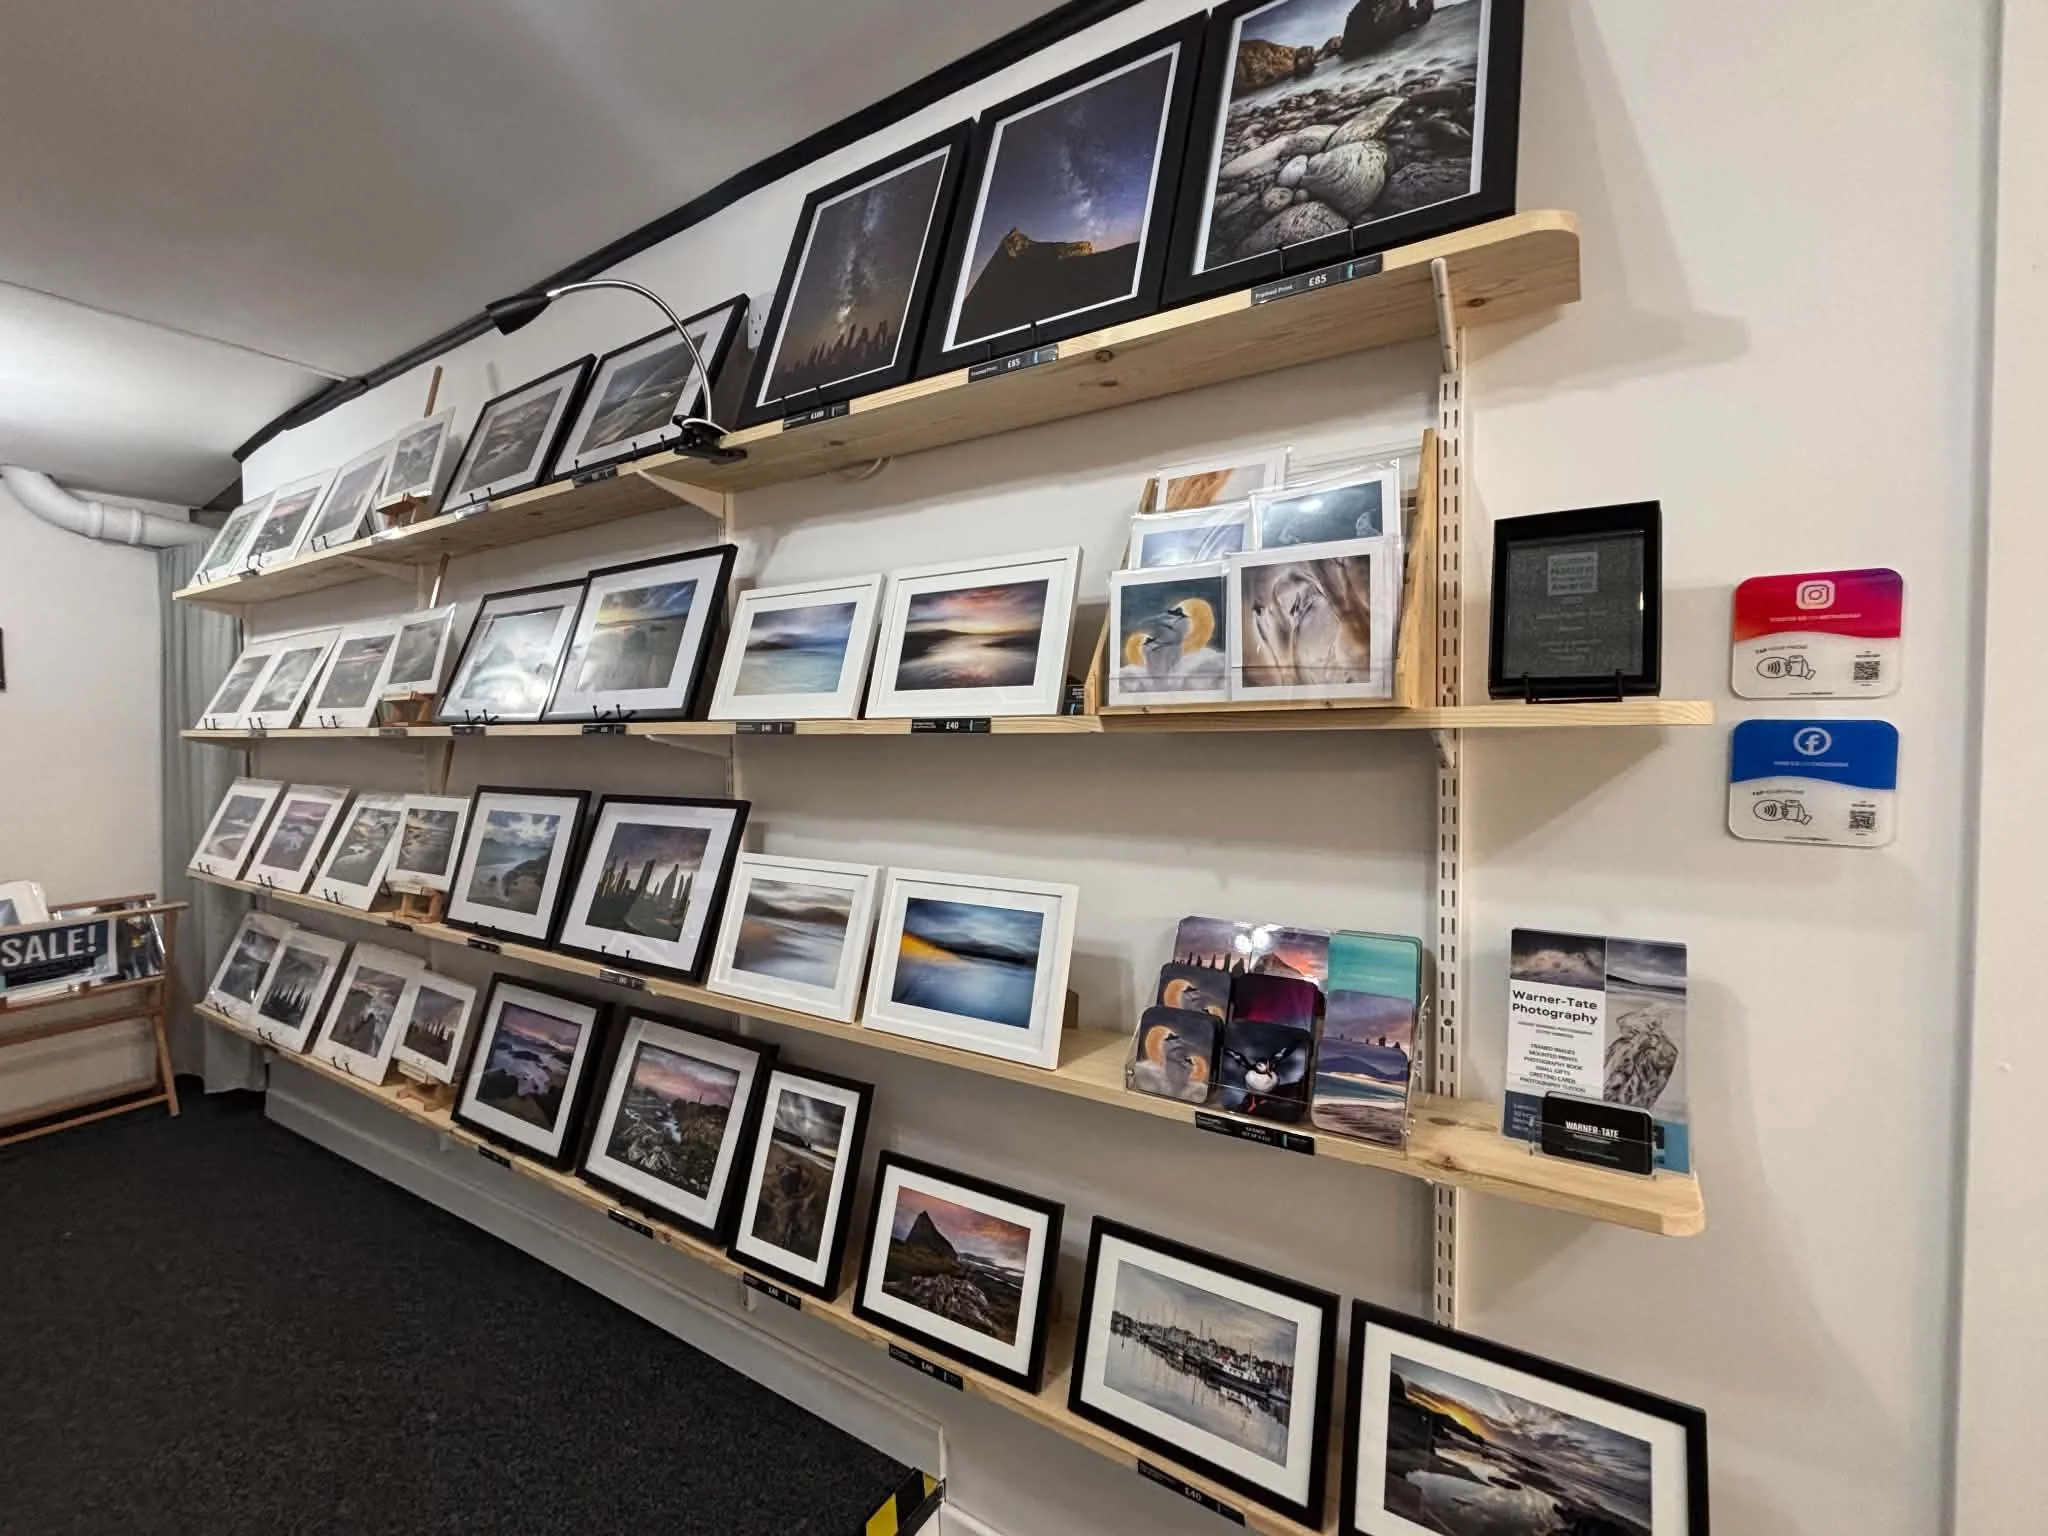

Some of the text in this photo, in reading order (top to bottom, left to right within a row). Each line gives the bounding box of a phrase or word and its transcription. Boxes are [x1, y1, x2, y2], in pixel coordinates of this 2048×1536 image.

[1308, 273, 1327, 287] £85
[945, 721, 960, 730] £40
[0, 924, 97, 968] SALE!
[1512, 989, 1598, 1010] Warner-Tate
[1512, 1002, 1598, 1025] Photography
